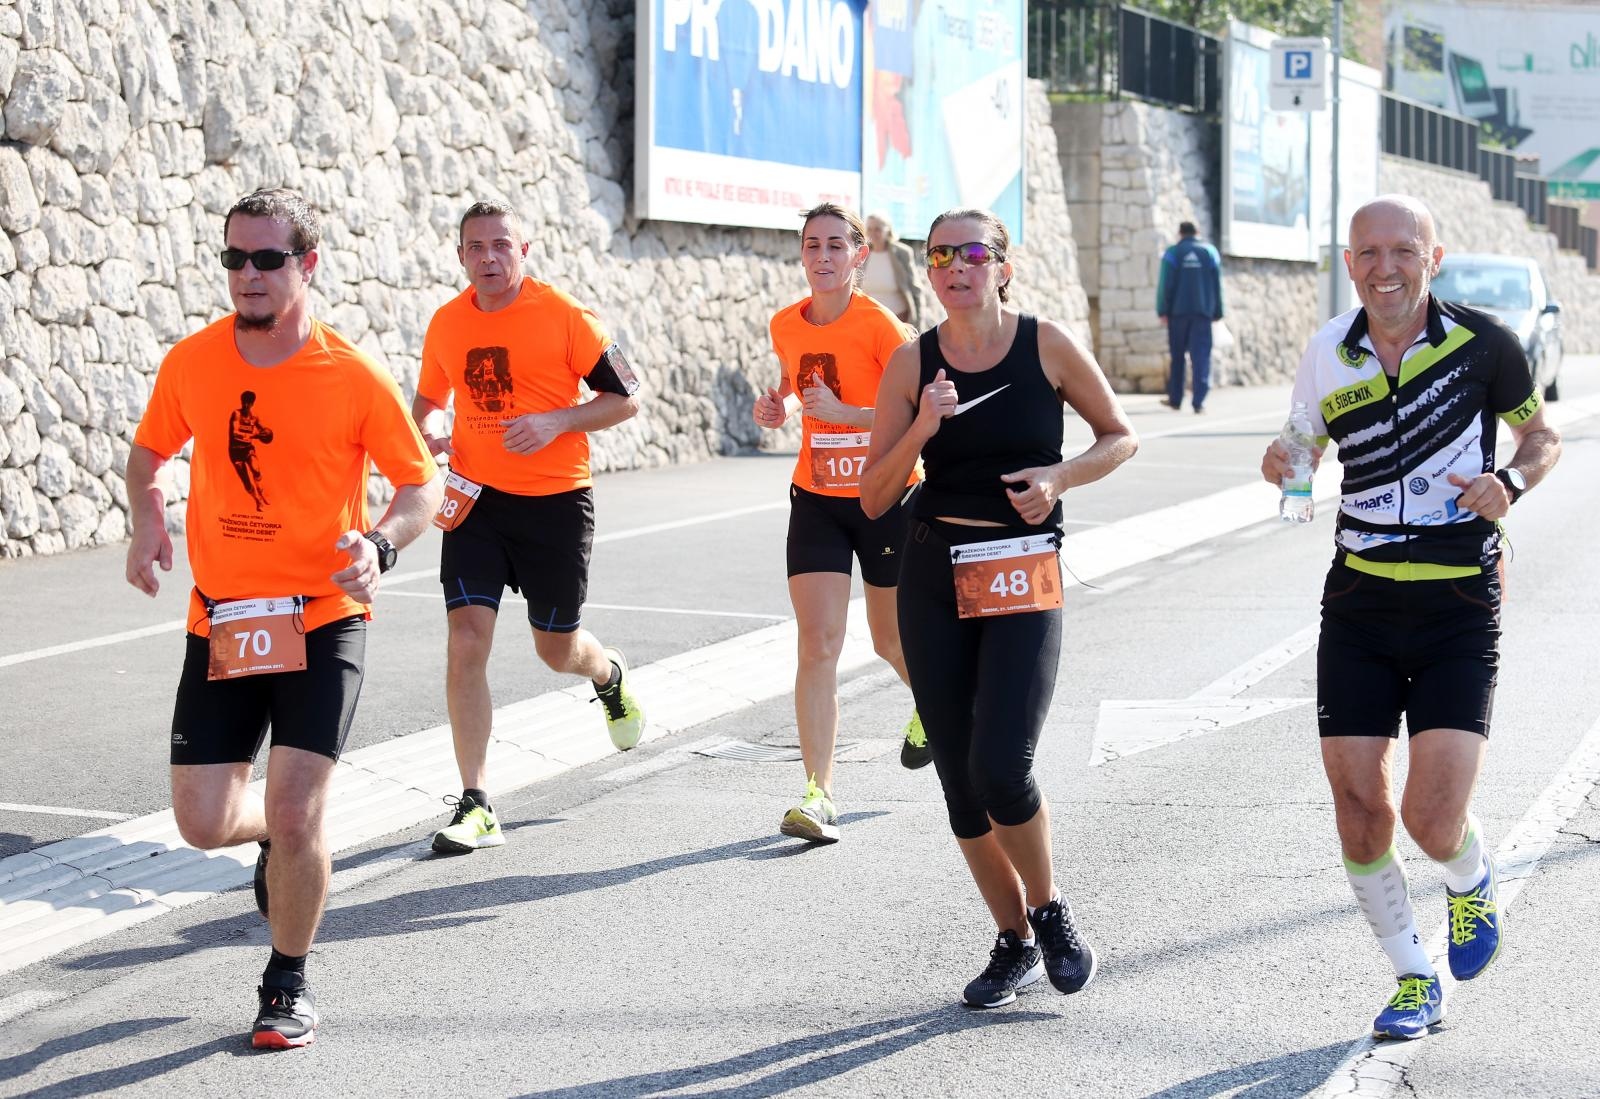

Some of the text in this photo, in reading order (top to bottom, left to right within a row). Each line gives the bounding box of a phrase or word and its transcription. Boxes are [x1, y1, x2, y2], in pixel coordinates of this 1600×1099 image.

[1289, 52, 1309, 79] P
[1335, 385, 1374, 410] ŠIBENIK
[1513, 404, 1533, 421] TK
[826, 456, 867, 478] 107
[1431, 466, 1447, 480] Auto
[989, 569, 1030, 598] 48
[234, 629, 272, 659] 70
